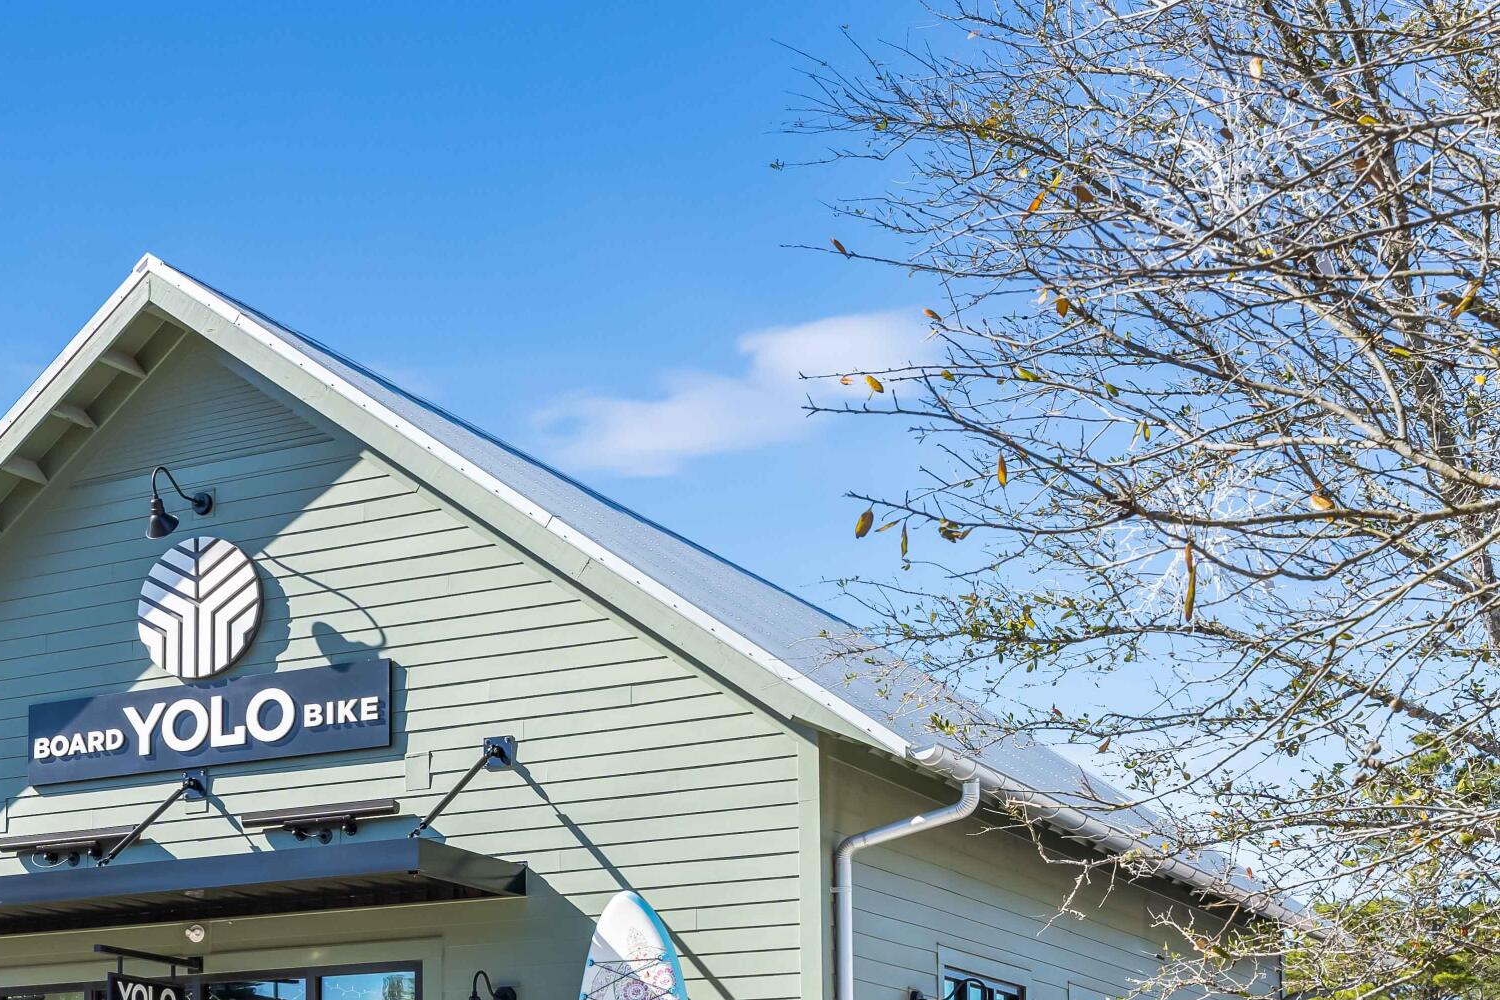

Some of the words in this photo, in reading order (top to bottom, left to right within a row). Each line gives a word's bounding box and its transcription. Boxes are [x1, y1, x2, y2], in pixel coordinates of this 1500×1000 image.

[33, 728, 125, 760] BOARD
[122, 687, 297, 756] YOLO
[303, 696, 380, 729] BIKE
